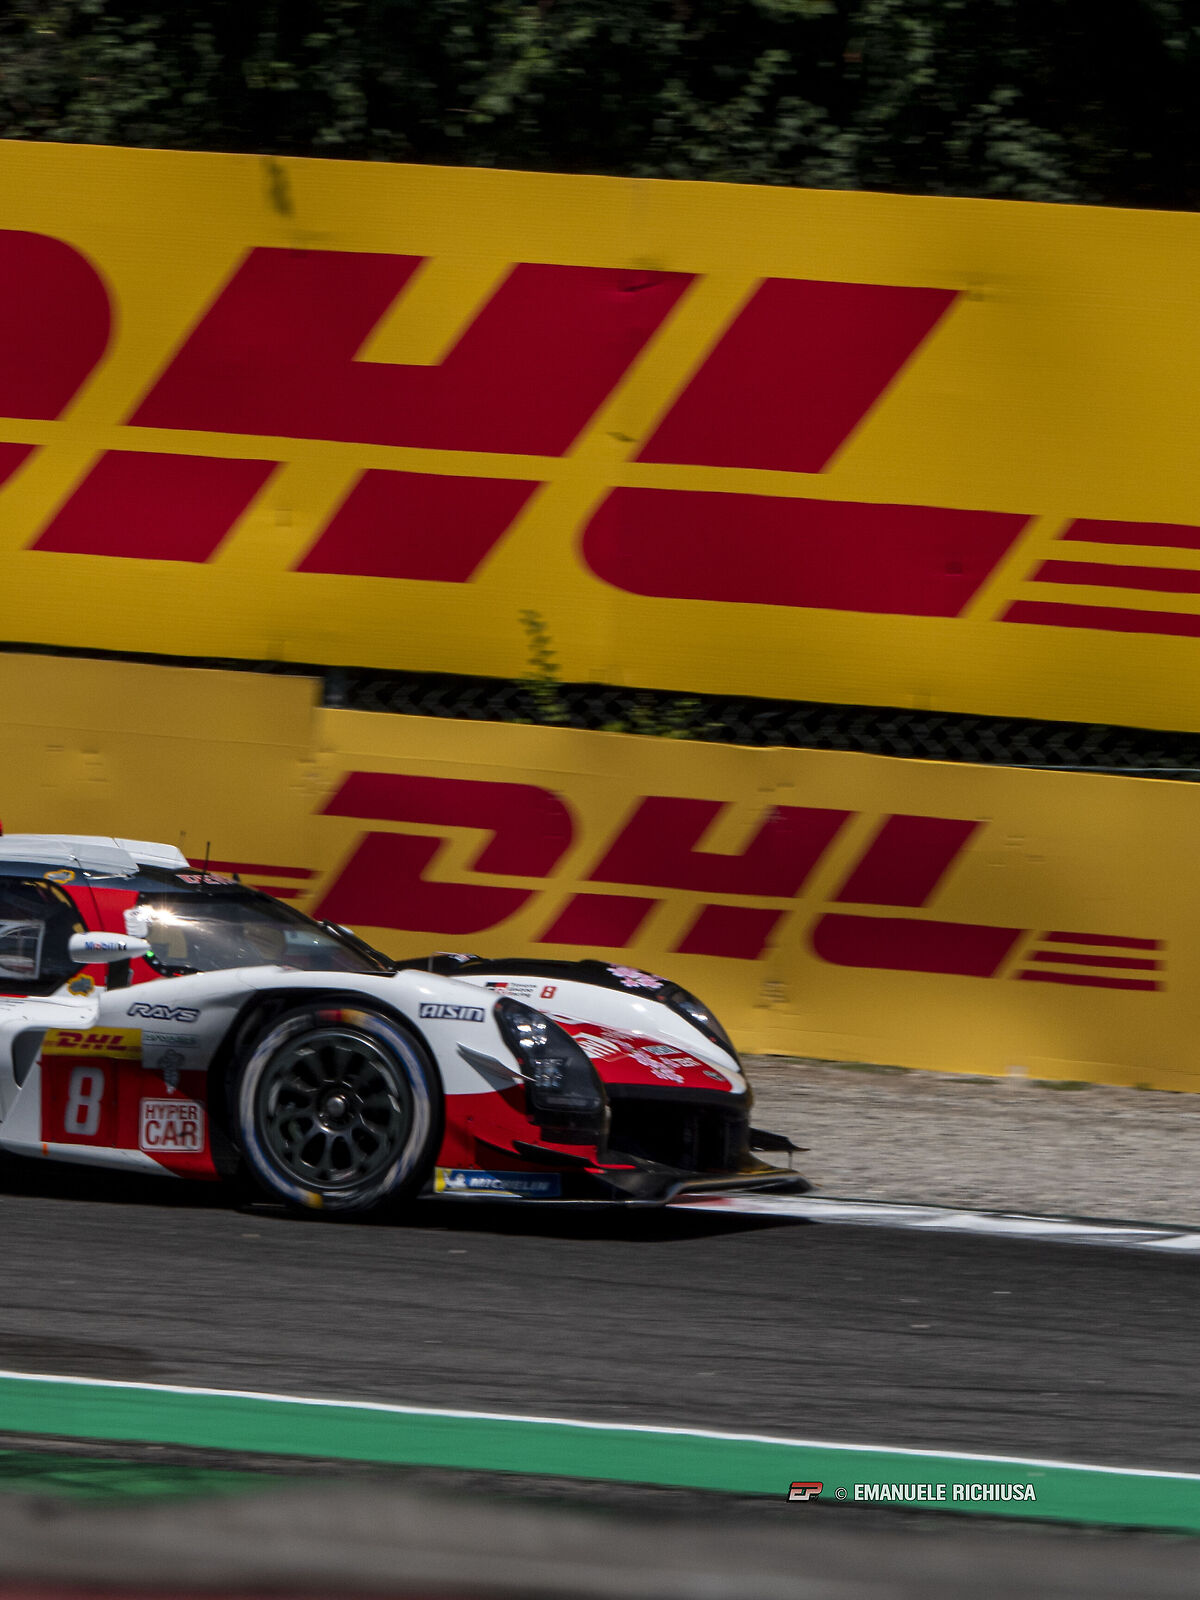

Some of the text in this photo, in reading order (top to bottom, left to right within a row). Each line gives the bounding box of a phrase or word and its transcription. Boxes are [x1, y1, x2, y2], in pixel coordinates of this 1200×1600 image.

[307, 771, 1030, 977] DHL
[540, 986, 557, 999] 8
[127, 1002, 201, 1023] RAYS
[57, 1032, 127, 1051] DHL
[64, 1066, 105, 1136] 8
[145, 1104, 198, 1120] HYPER
[145, 1120, 198, 1146] CAR
